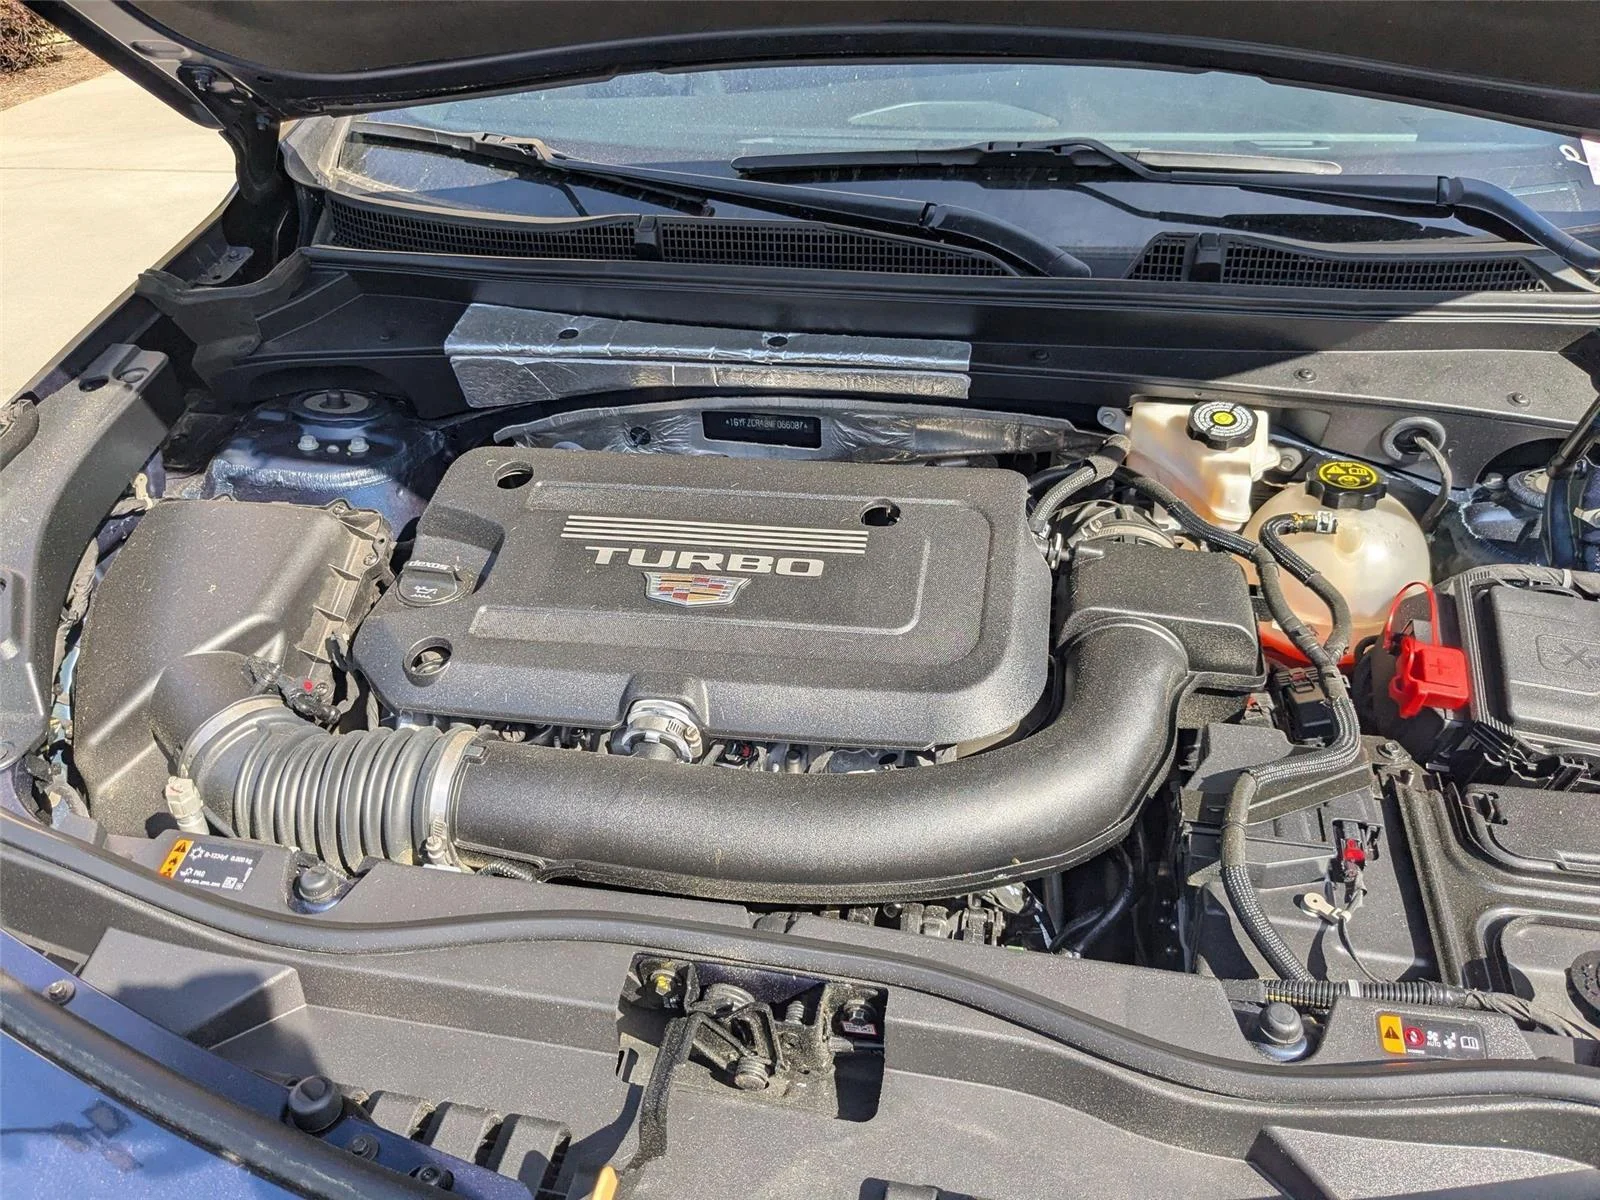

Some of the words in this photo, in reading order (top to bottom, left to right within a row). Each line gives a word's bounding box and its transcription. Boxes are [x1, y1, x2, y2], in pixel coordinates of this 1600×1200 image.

[408, 560, 451, 571] dexos
[585, 546, 824, 577] TURBO
[1427, 1040, 1441, 1048] AUTO
